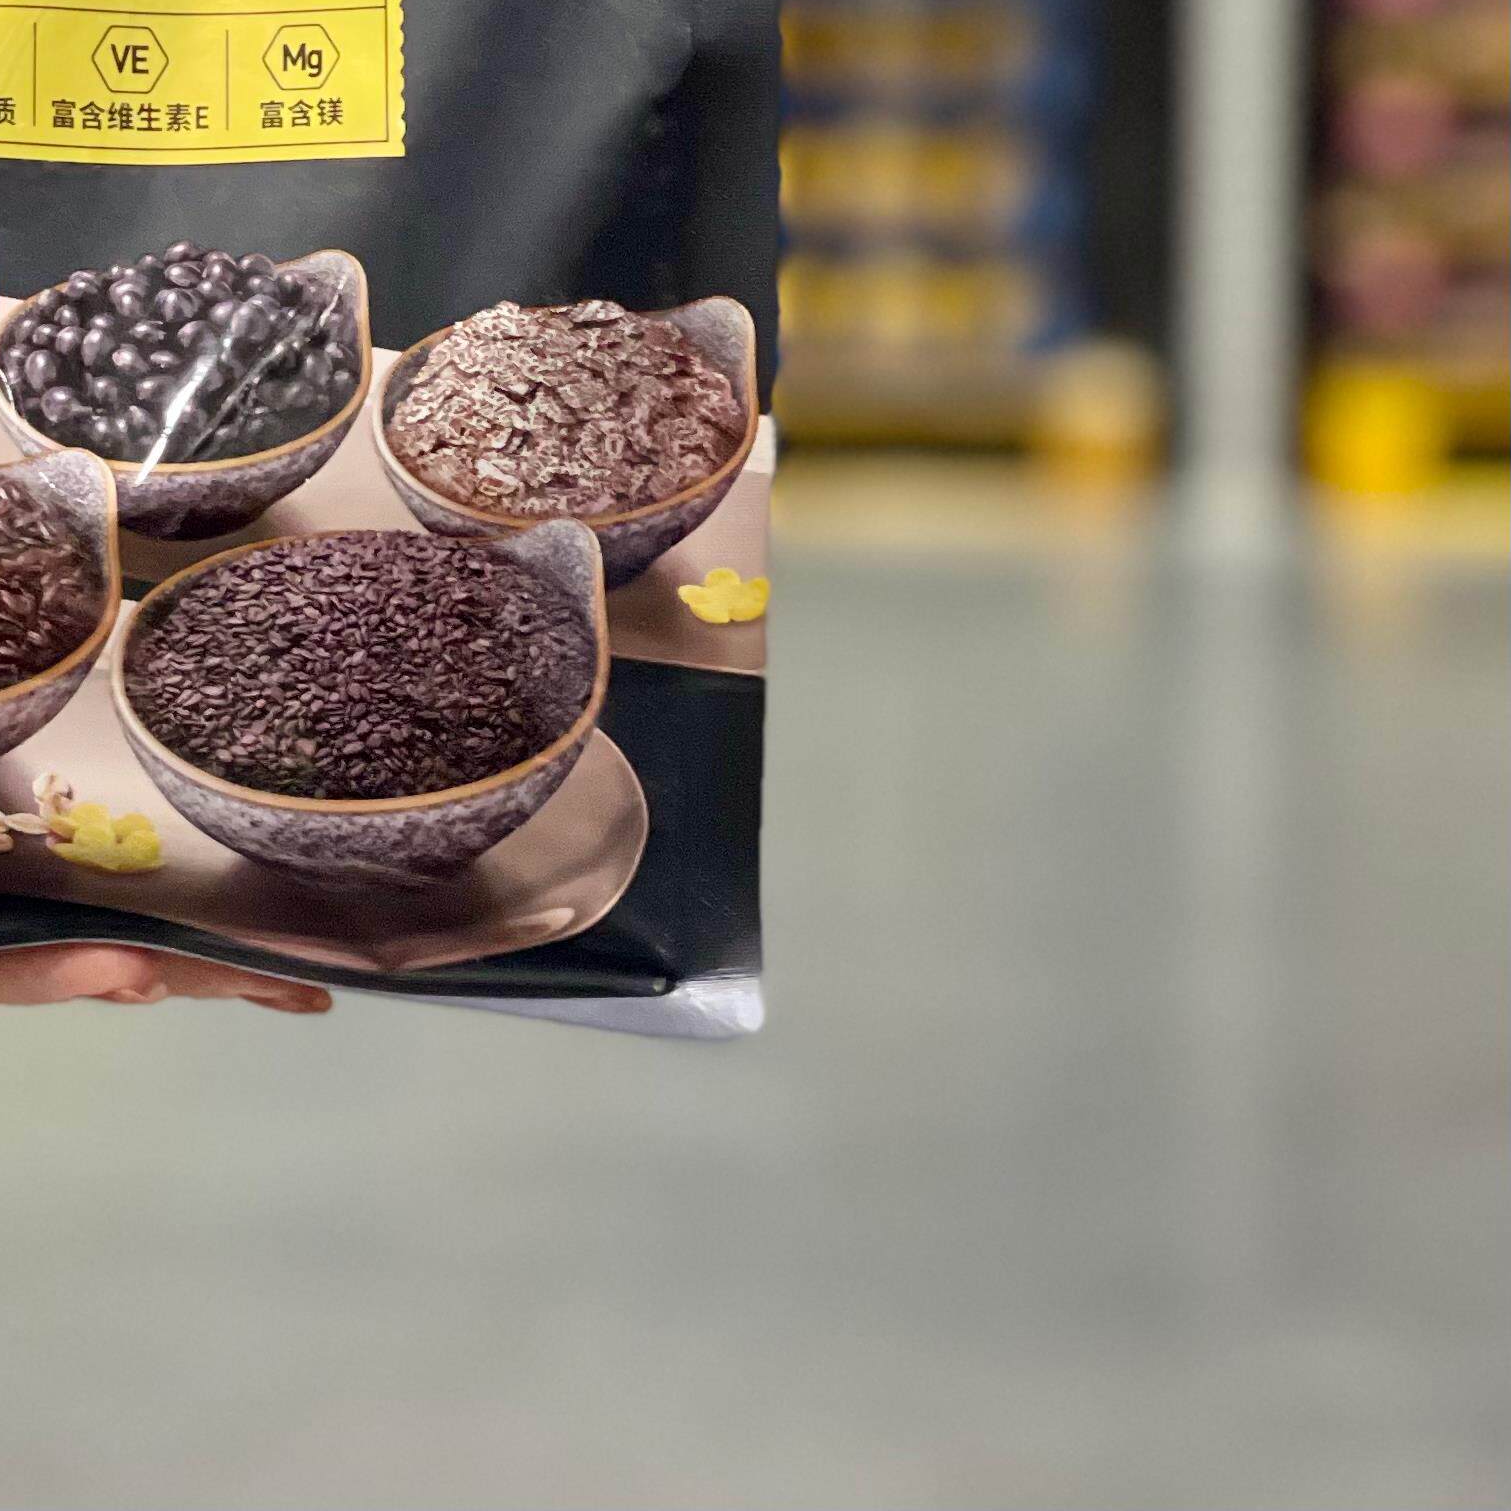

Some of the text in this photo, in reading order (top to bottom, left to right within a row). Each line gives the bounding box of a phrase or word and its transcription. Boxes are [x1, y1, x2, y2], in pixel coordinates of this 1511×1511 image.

[110, 43, 149, 74] VE
[282, 42, 323, 78] Mg
[51, 98, 209, 132] 富含维生素E
[260, 96, 344, 129] 富含镁
